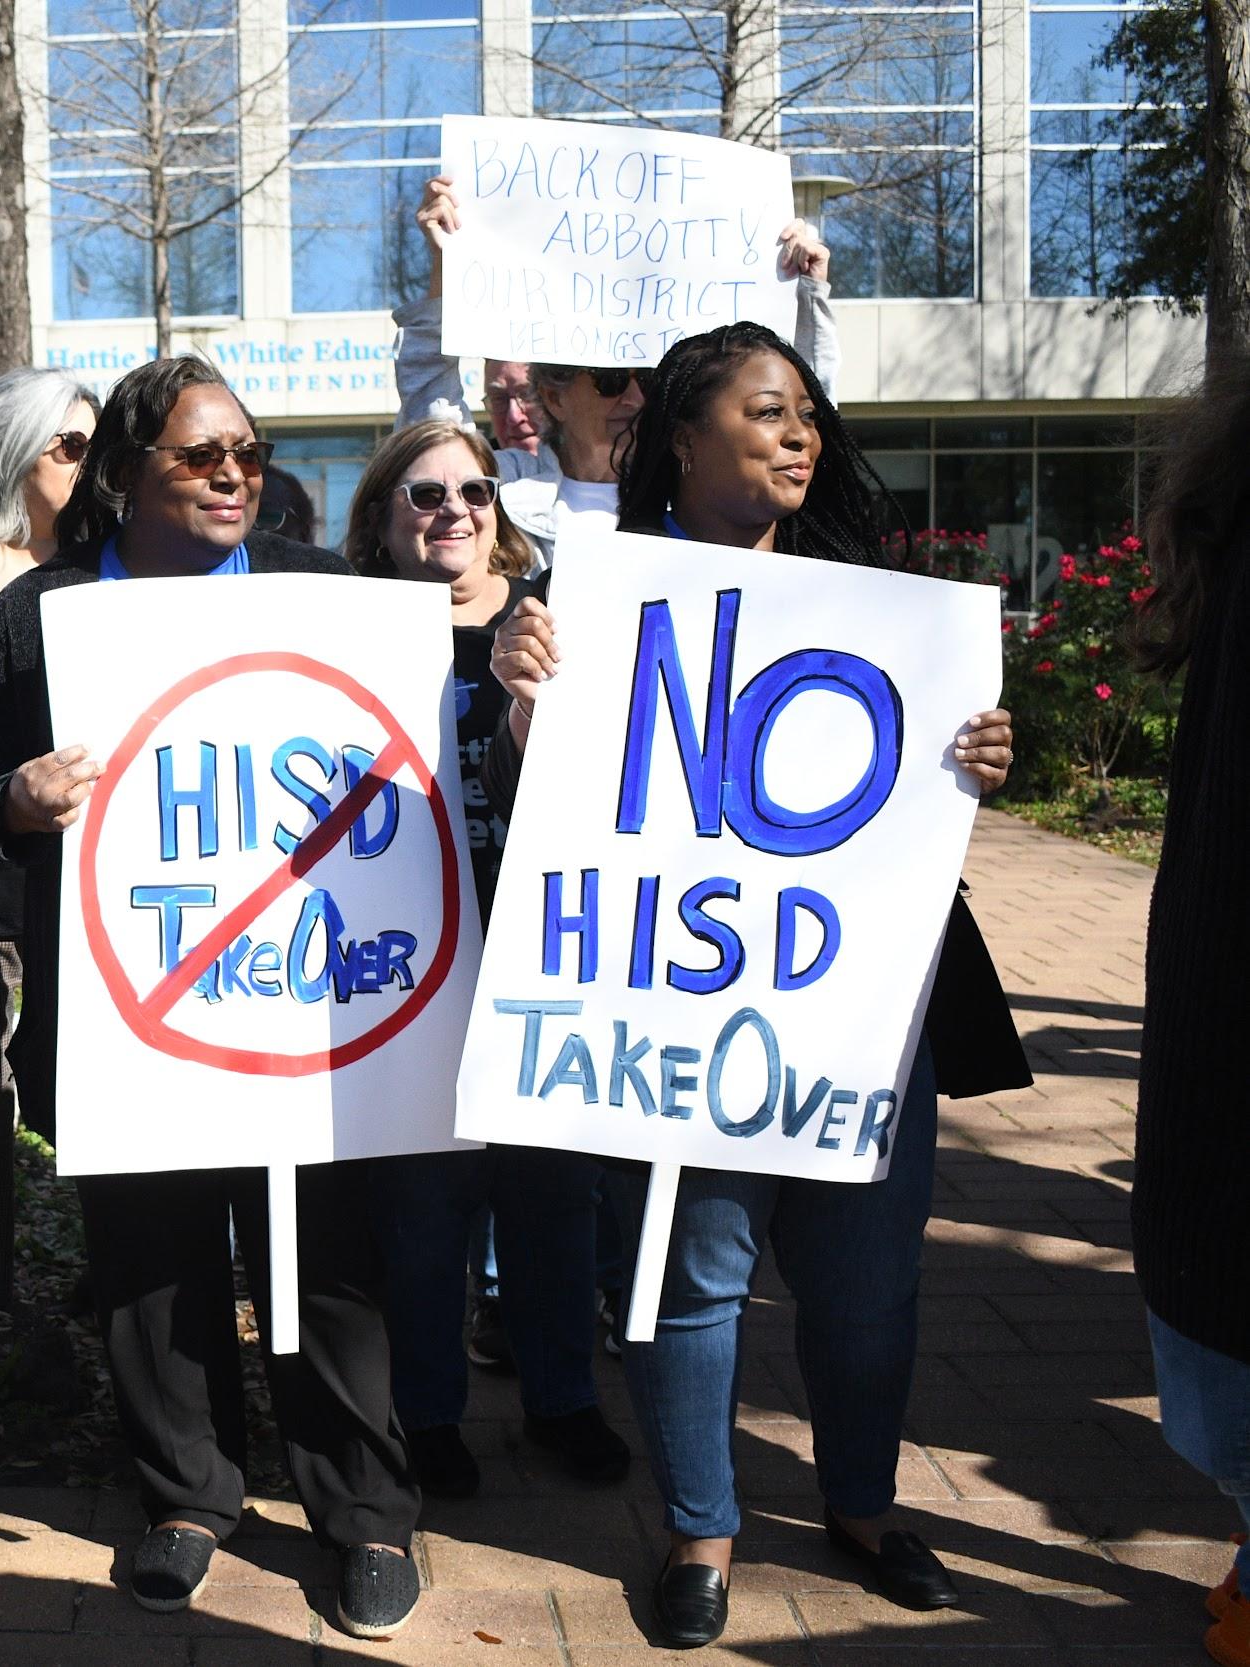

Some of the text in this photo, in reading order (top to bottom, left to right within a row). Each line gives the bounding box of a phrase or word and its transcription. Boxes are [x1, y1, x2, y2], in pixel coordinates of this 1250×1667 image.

[473, 140, 706, 204] BACK OFF
[461, 260, 756, 323] OUR DISTRICT
[46, 347, 136, 369] Hattie
[215, 342, 303, 365] White
[509, 319, 647, 361] BELONGS
[614, 587, 904, 858] NO
[158, 736, 399, 860] HISD
[541, 868, 842, 995] HISD
